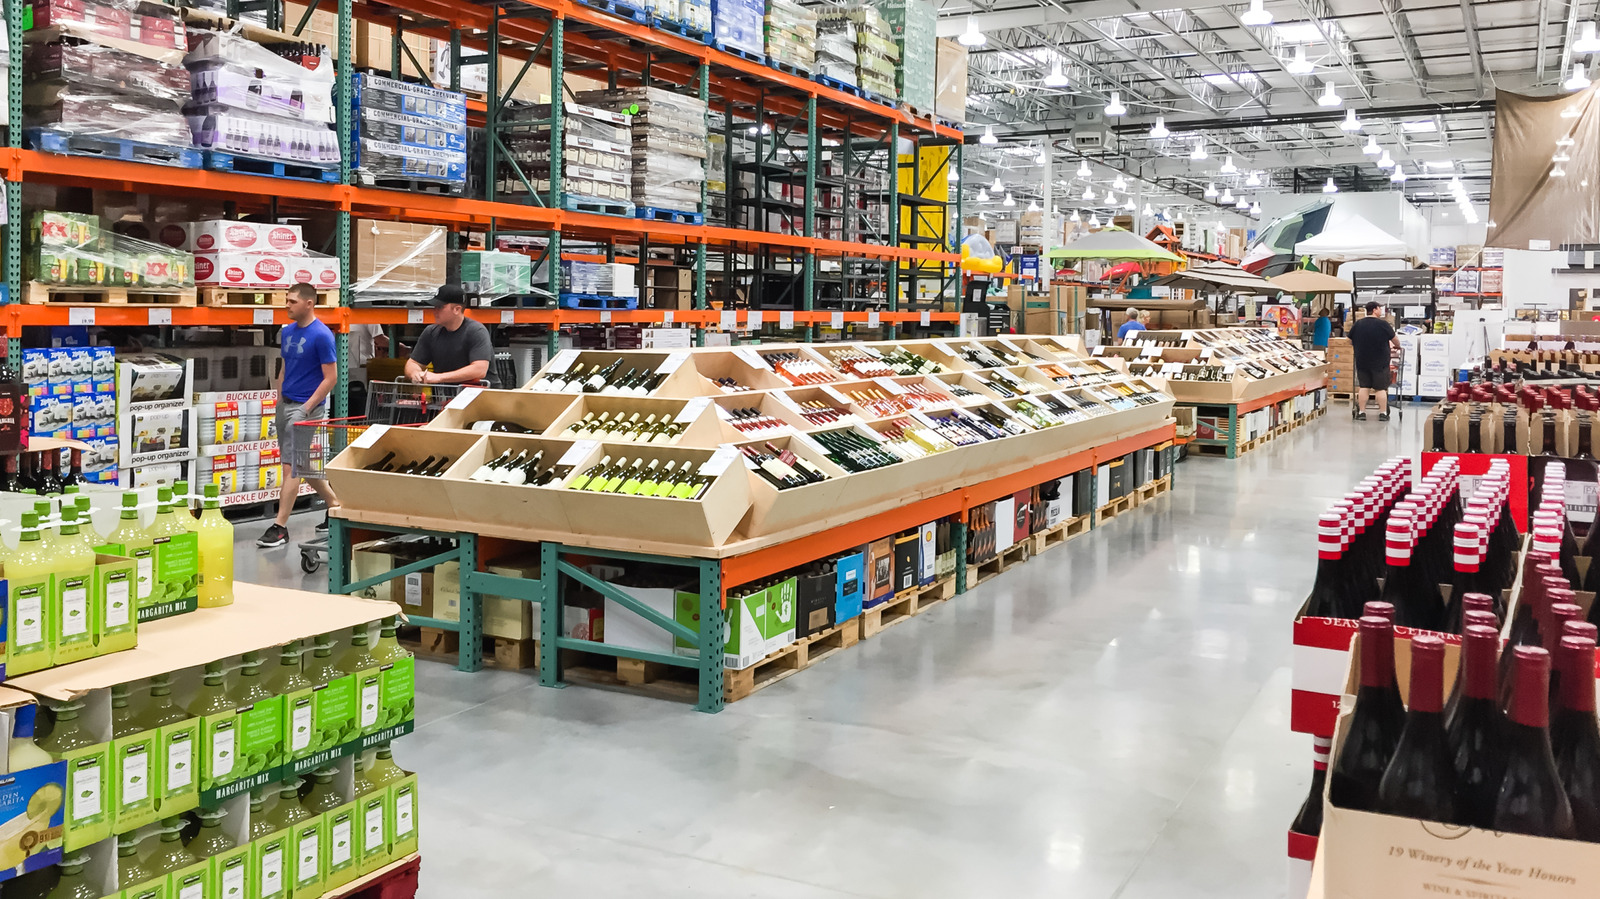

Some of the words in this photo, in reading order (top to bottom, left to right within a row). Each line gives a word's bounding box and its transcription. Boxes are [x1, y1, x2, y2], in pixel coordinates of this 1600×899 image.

[374, 79, 431, 96] COMMERCIAL-GRADE
[272, 231, 294, 240] Shiner
[146, 262, 168, 276] XX
[259, 262, 281, 272] Shiner
[226, 392, 258, 400] BUCKLE
[130, 404, 153, 412] pop-up
[155, 401, 184, 410] organizer
[227, 442, 258, 453] BUCKLE
[260, 442, 270, 450] UP
[132, 454, 156, 464] pop-up
[158, 450, 190, 460] organizer
[225, 493, 256, 504] BUCKLE
[258, 491, 268, 500] UP
[175, 600, 187, 612] MIX
[1323, 618, 1360, 628] SEAS
[362, 729, 394, 747] MARGARITA
[394, 725, 405, 735] MIX
[294, 752, 329, 772] MARGARITA
[330, 748, 342, 760] MIX
[216, 777, 255, 800] MARGARITA
[256, 772, 270, 786] MIX
[0, 796, 24, 806] ARITA
[2, 792, 18, 800] DEN
[1388, 846, 1404, 857] 19
[1408, 848, 1452, 868] Winery
[1456, 856, 1470, 870] of
[1473, 859, 1492, 871] the
[1496, 862, 1524, 876] Year
[1528, 868, 1576, 885] Honors
[1423, 882, 1451, 894] WINE
